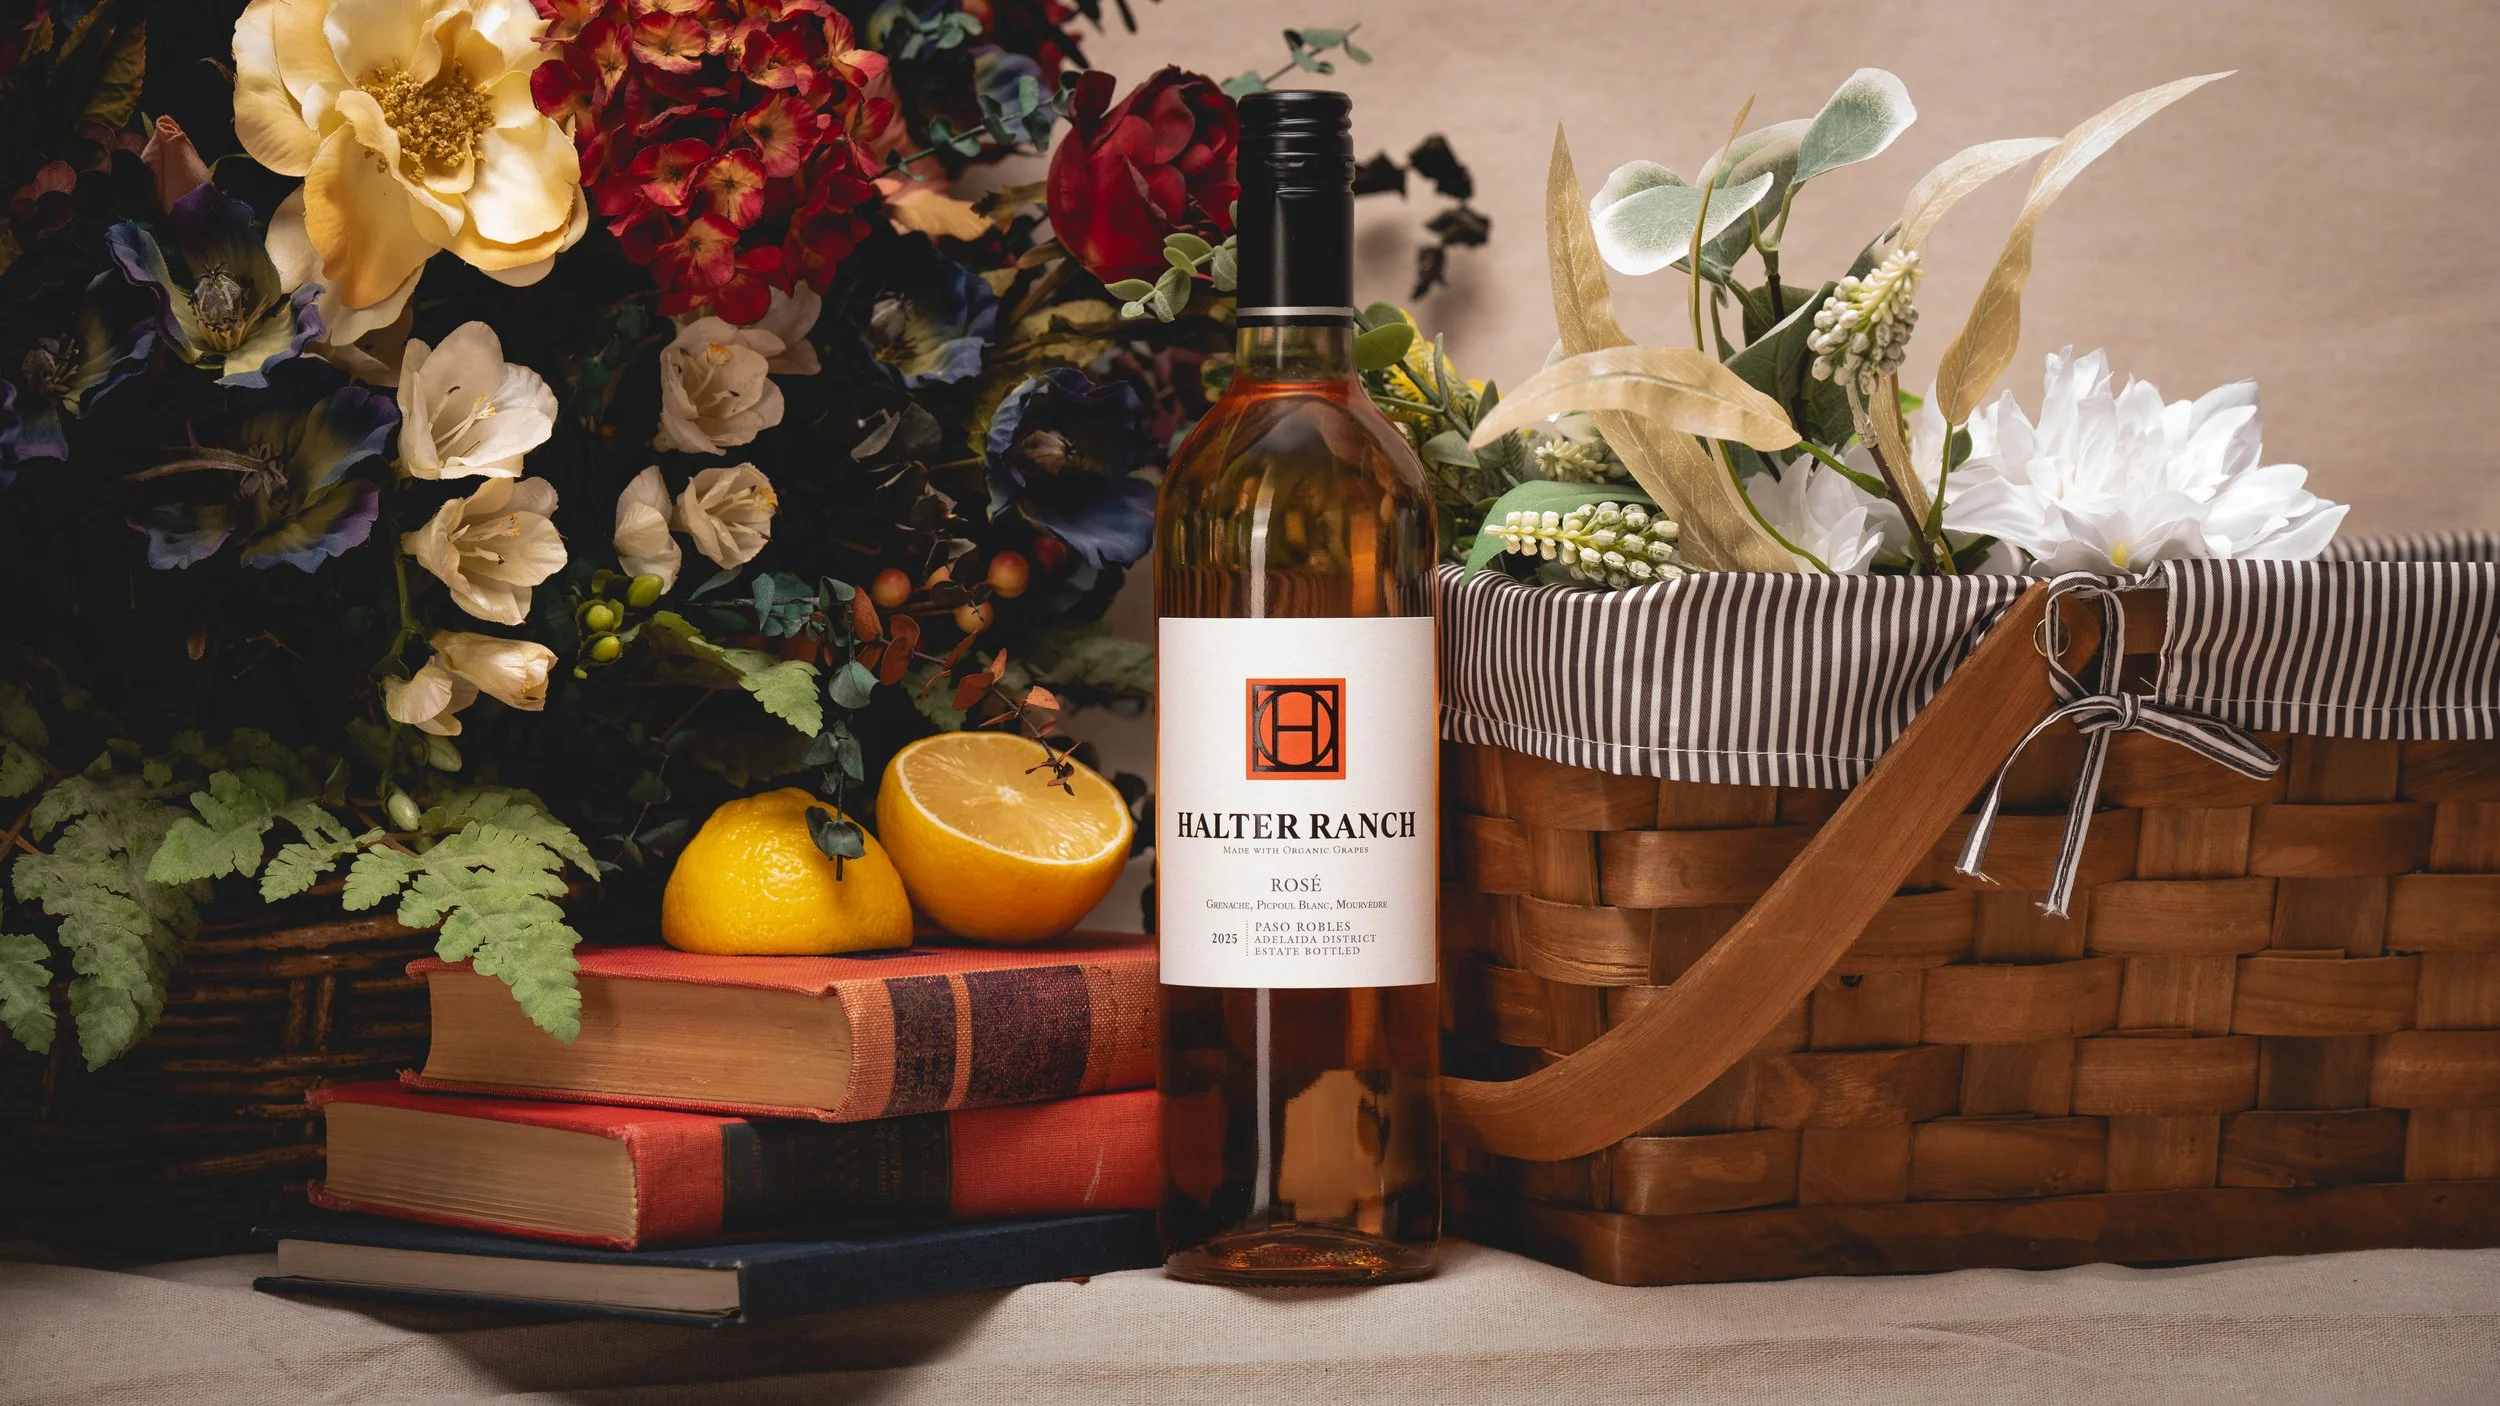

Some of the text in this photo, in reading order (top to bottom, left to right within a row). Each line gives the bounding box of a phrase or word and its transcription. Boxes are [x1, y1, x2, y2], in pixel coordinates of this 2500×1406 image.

[1178, 812, 1415, 839] HALTER RANCH
[1271, 873, 1322, 893] ROSÉ
[1255, 921, 1351, 932] PASO ROBLES
[1211, 932, 1238, 945] 2025
[1254, 934, 1377, 944] ADELAIDA DISTRICT
[1255, 946, 1361, 956] ESTATE BOTTLED
